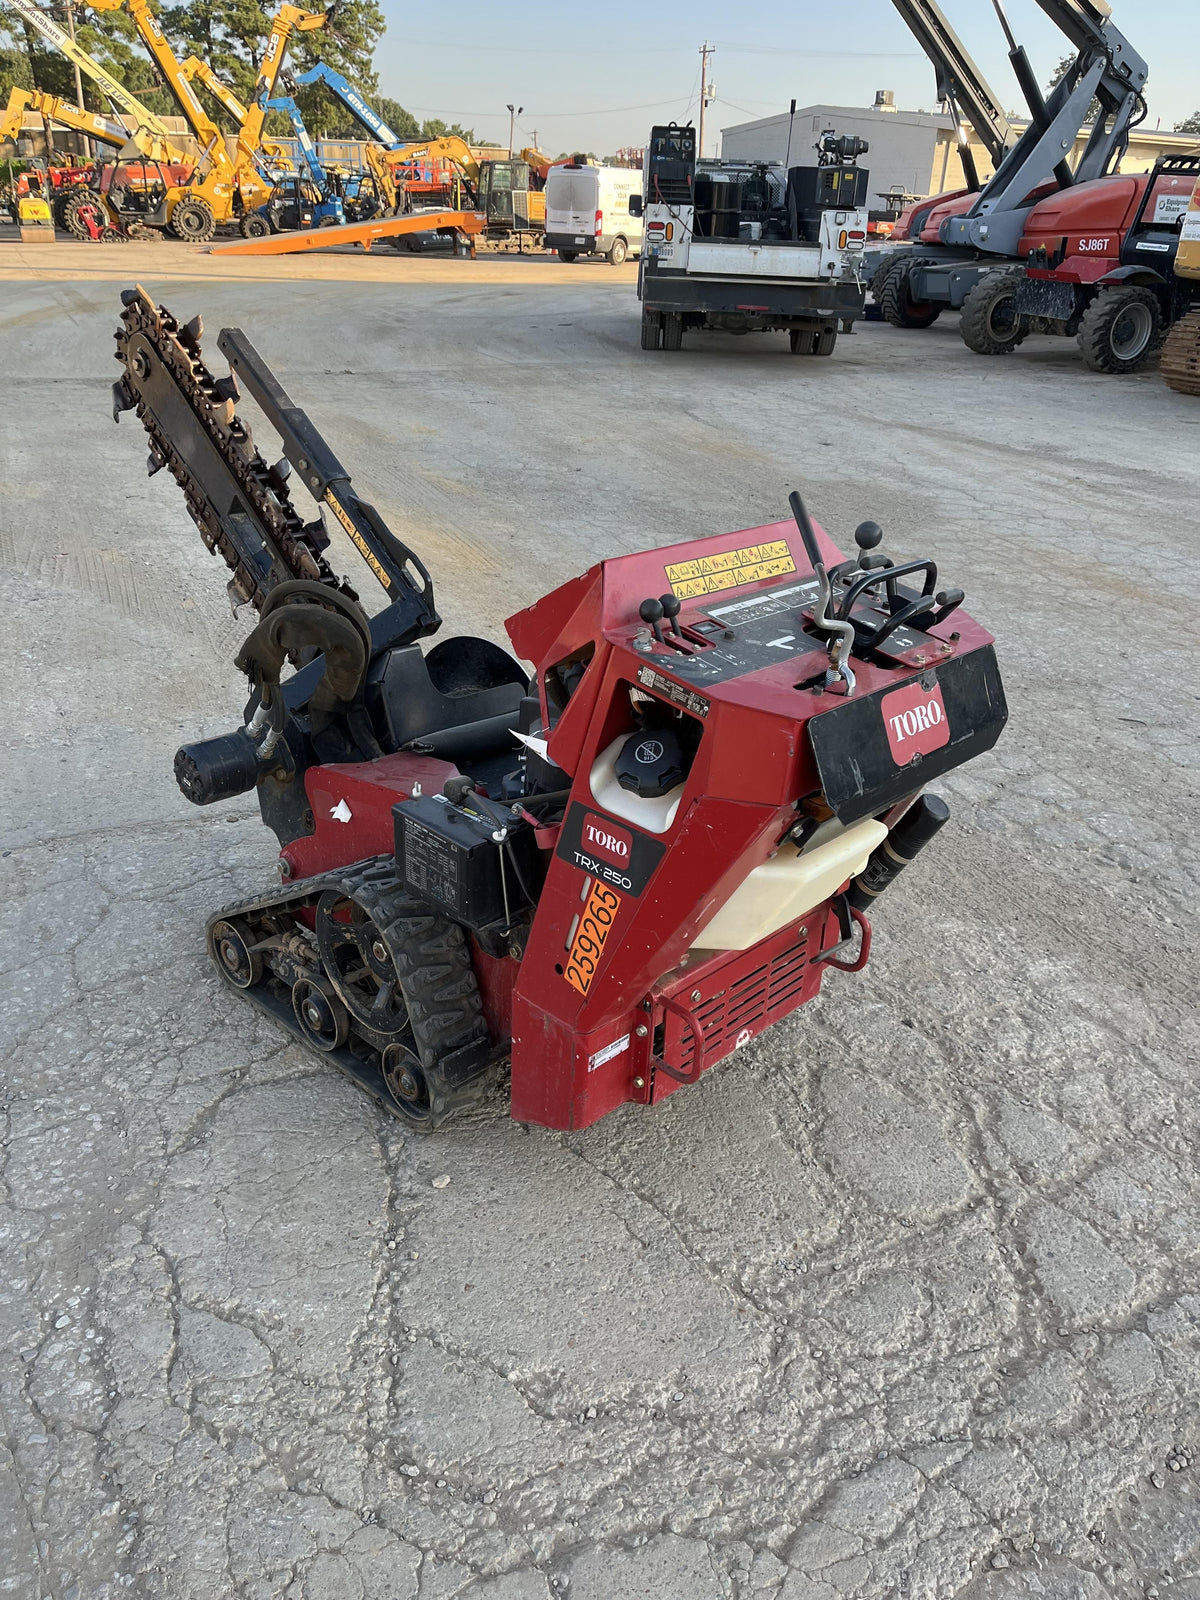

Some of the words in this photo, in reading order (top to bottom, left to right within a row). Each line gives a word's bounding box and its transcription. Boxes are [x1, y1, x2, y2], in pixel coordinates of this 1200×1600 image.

[145, 14, 161, 38] JCB
[265, 33, 280, 63] JCB
[96, 76, 112, 89] JLG
[111, 90, 131, 106] LIFT
[1078, 238, 1110, 251] SJ86T
[889, 699, 943, 743] TORO
[586, 824, 628, 857] TORO
[566, 883, 618, 993] 259265
